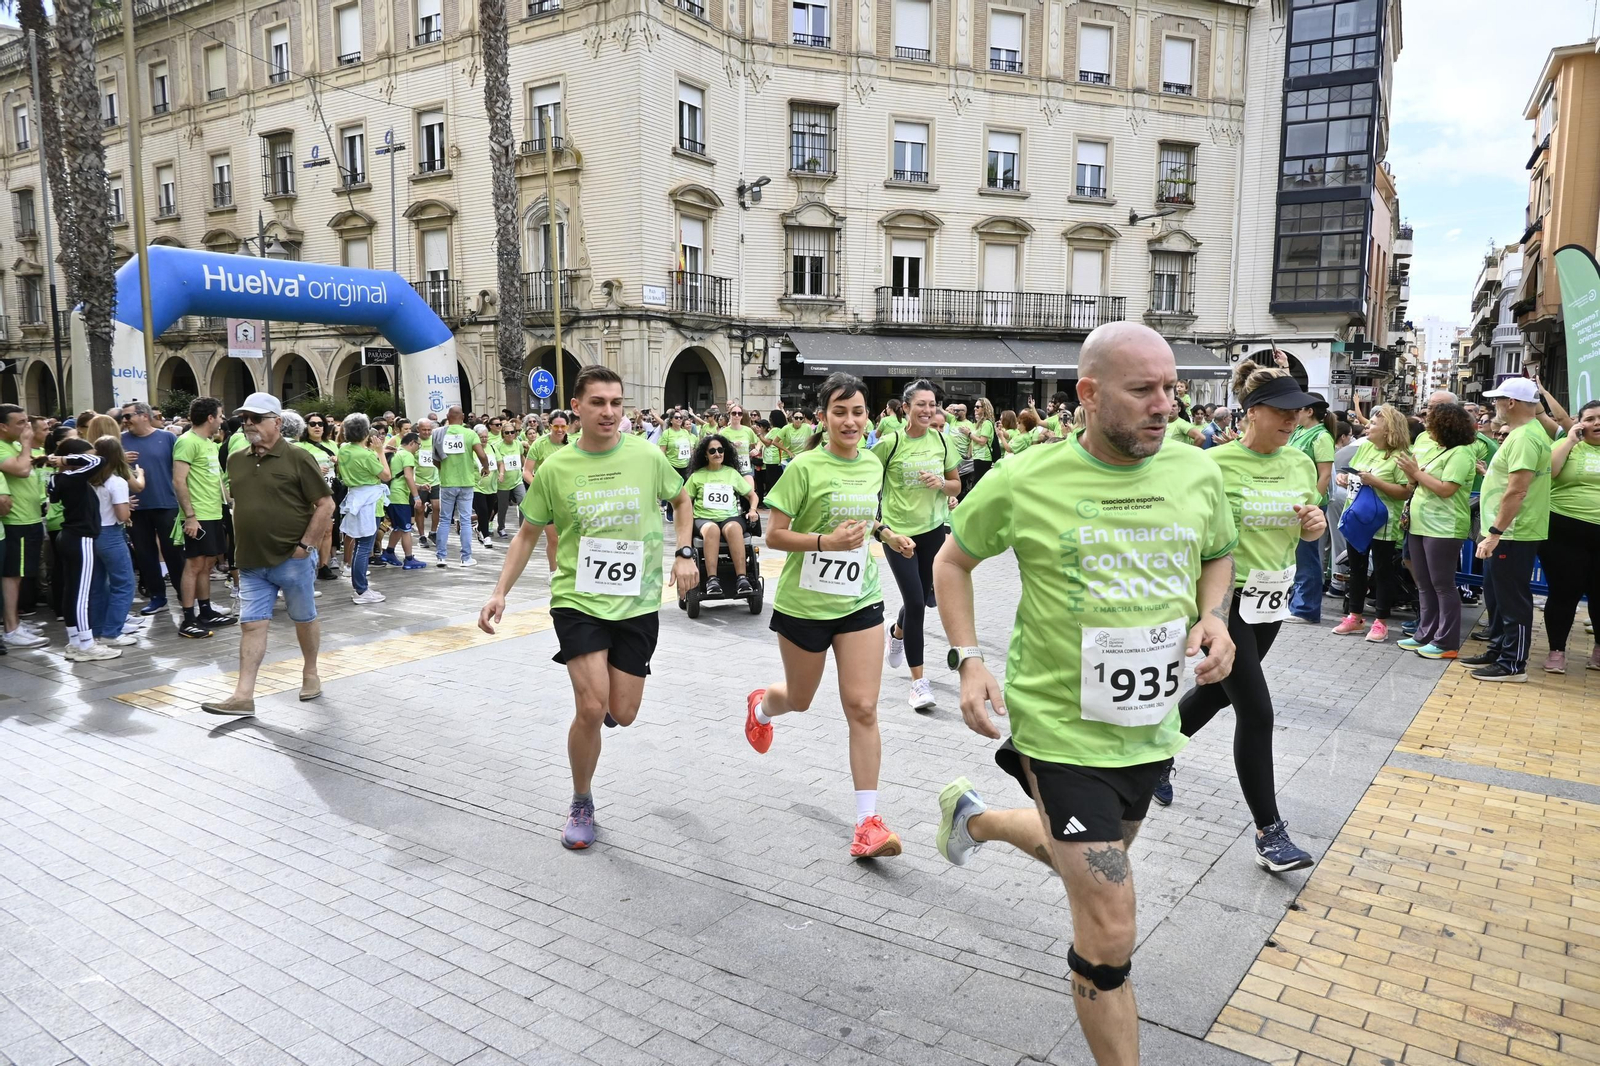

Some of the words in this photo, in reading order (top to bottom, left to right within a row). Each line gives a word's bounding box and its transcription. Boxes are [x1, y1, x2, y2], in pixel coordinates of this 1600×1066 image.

[202, 264, 300, 298] Huelva
[308, 276, 387, 307] original
[888, 367, 917, 375] RESTAURANTE
[576, 490, 592, 501] En
[594, 485, 641, 499] marcha
[708, 492, 729, 503] 630
[831, 491, 847, 502] En
[1242, 487, 1259, 497] En
[577, 500, 625, 515] contra
[626, 497, 641, 510] el
[1136, 496, 1165, 504] española
[1243, 500, 1293, 512] contra
[831, 504, 872, 517] contra
[1079, 526, 1109, 545] En
[1113, 522, 1197, 542] marcha
[1081, 548, 1169, 572] contra
[1172, 546, 1190, 567] el
[1059, 528, 1086, 613] HUELVA
[1144, 603, 1171, 611] HUELVA
